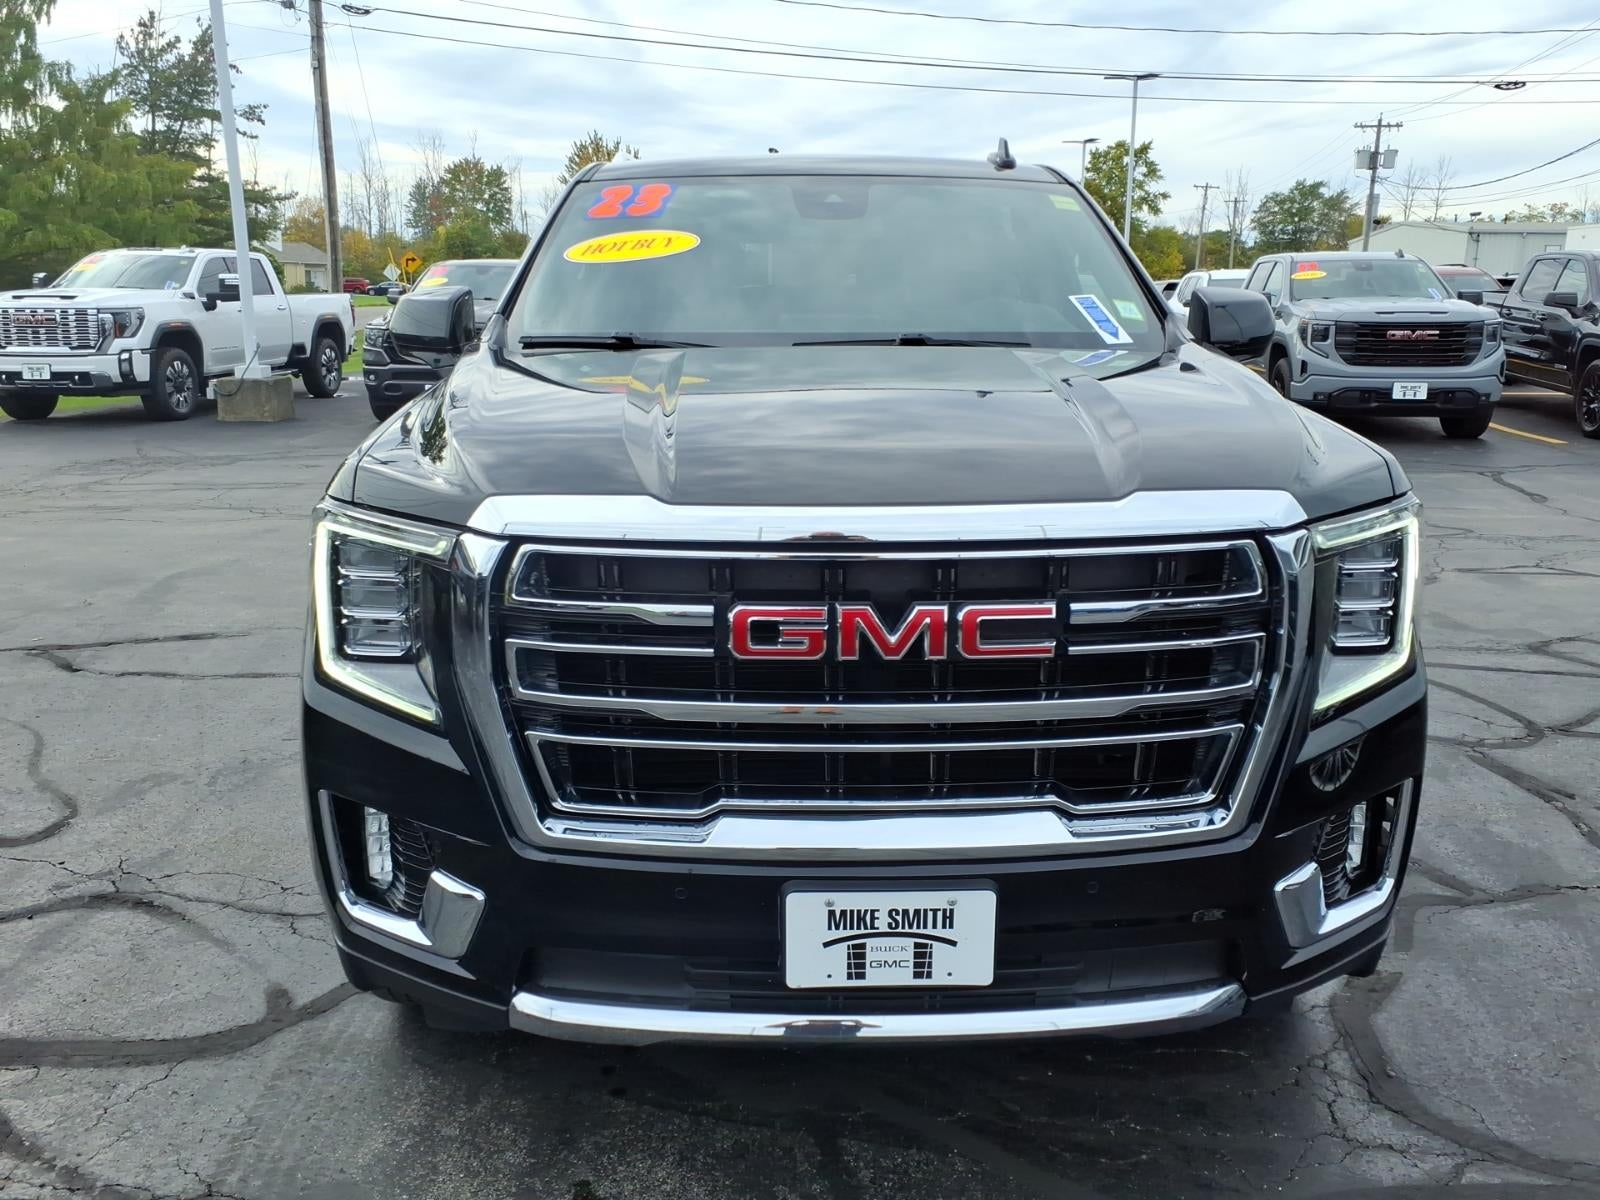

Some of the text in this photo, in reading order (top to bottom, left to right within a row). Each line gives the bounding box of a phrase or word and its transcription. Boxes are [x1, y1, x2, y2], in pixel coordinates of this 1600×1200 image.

[630, 236, 680, 251] BUY
[1386, 330, 1440, 341] GMC
[728, 602, 1057, 660] GMC
[827, 908, 955, 931] MIKE SMITH
[870, 945, 910, 953] BUICK
[869, 959, 910, 969] GMC
